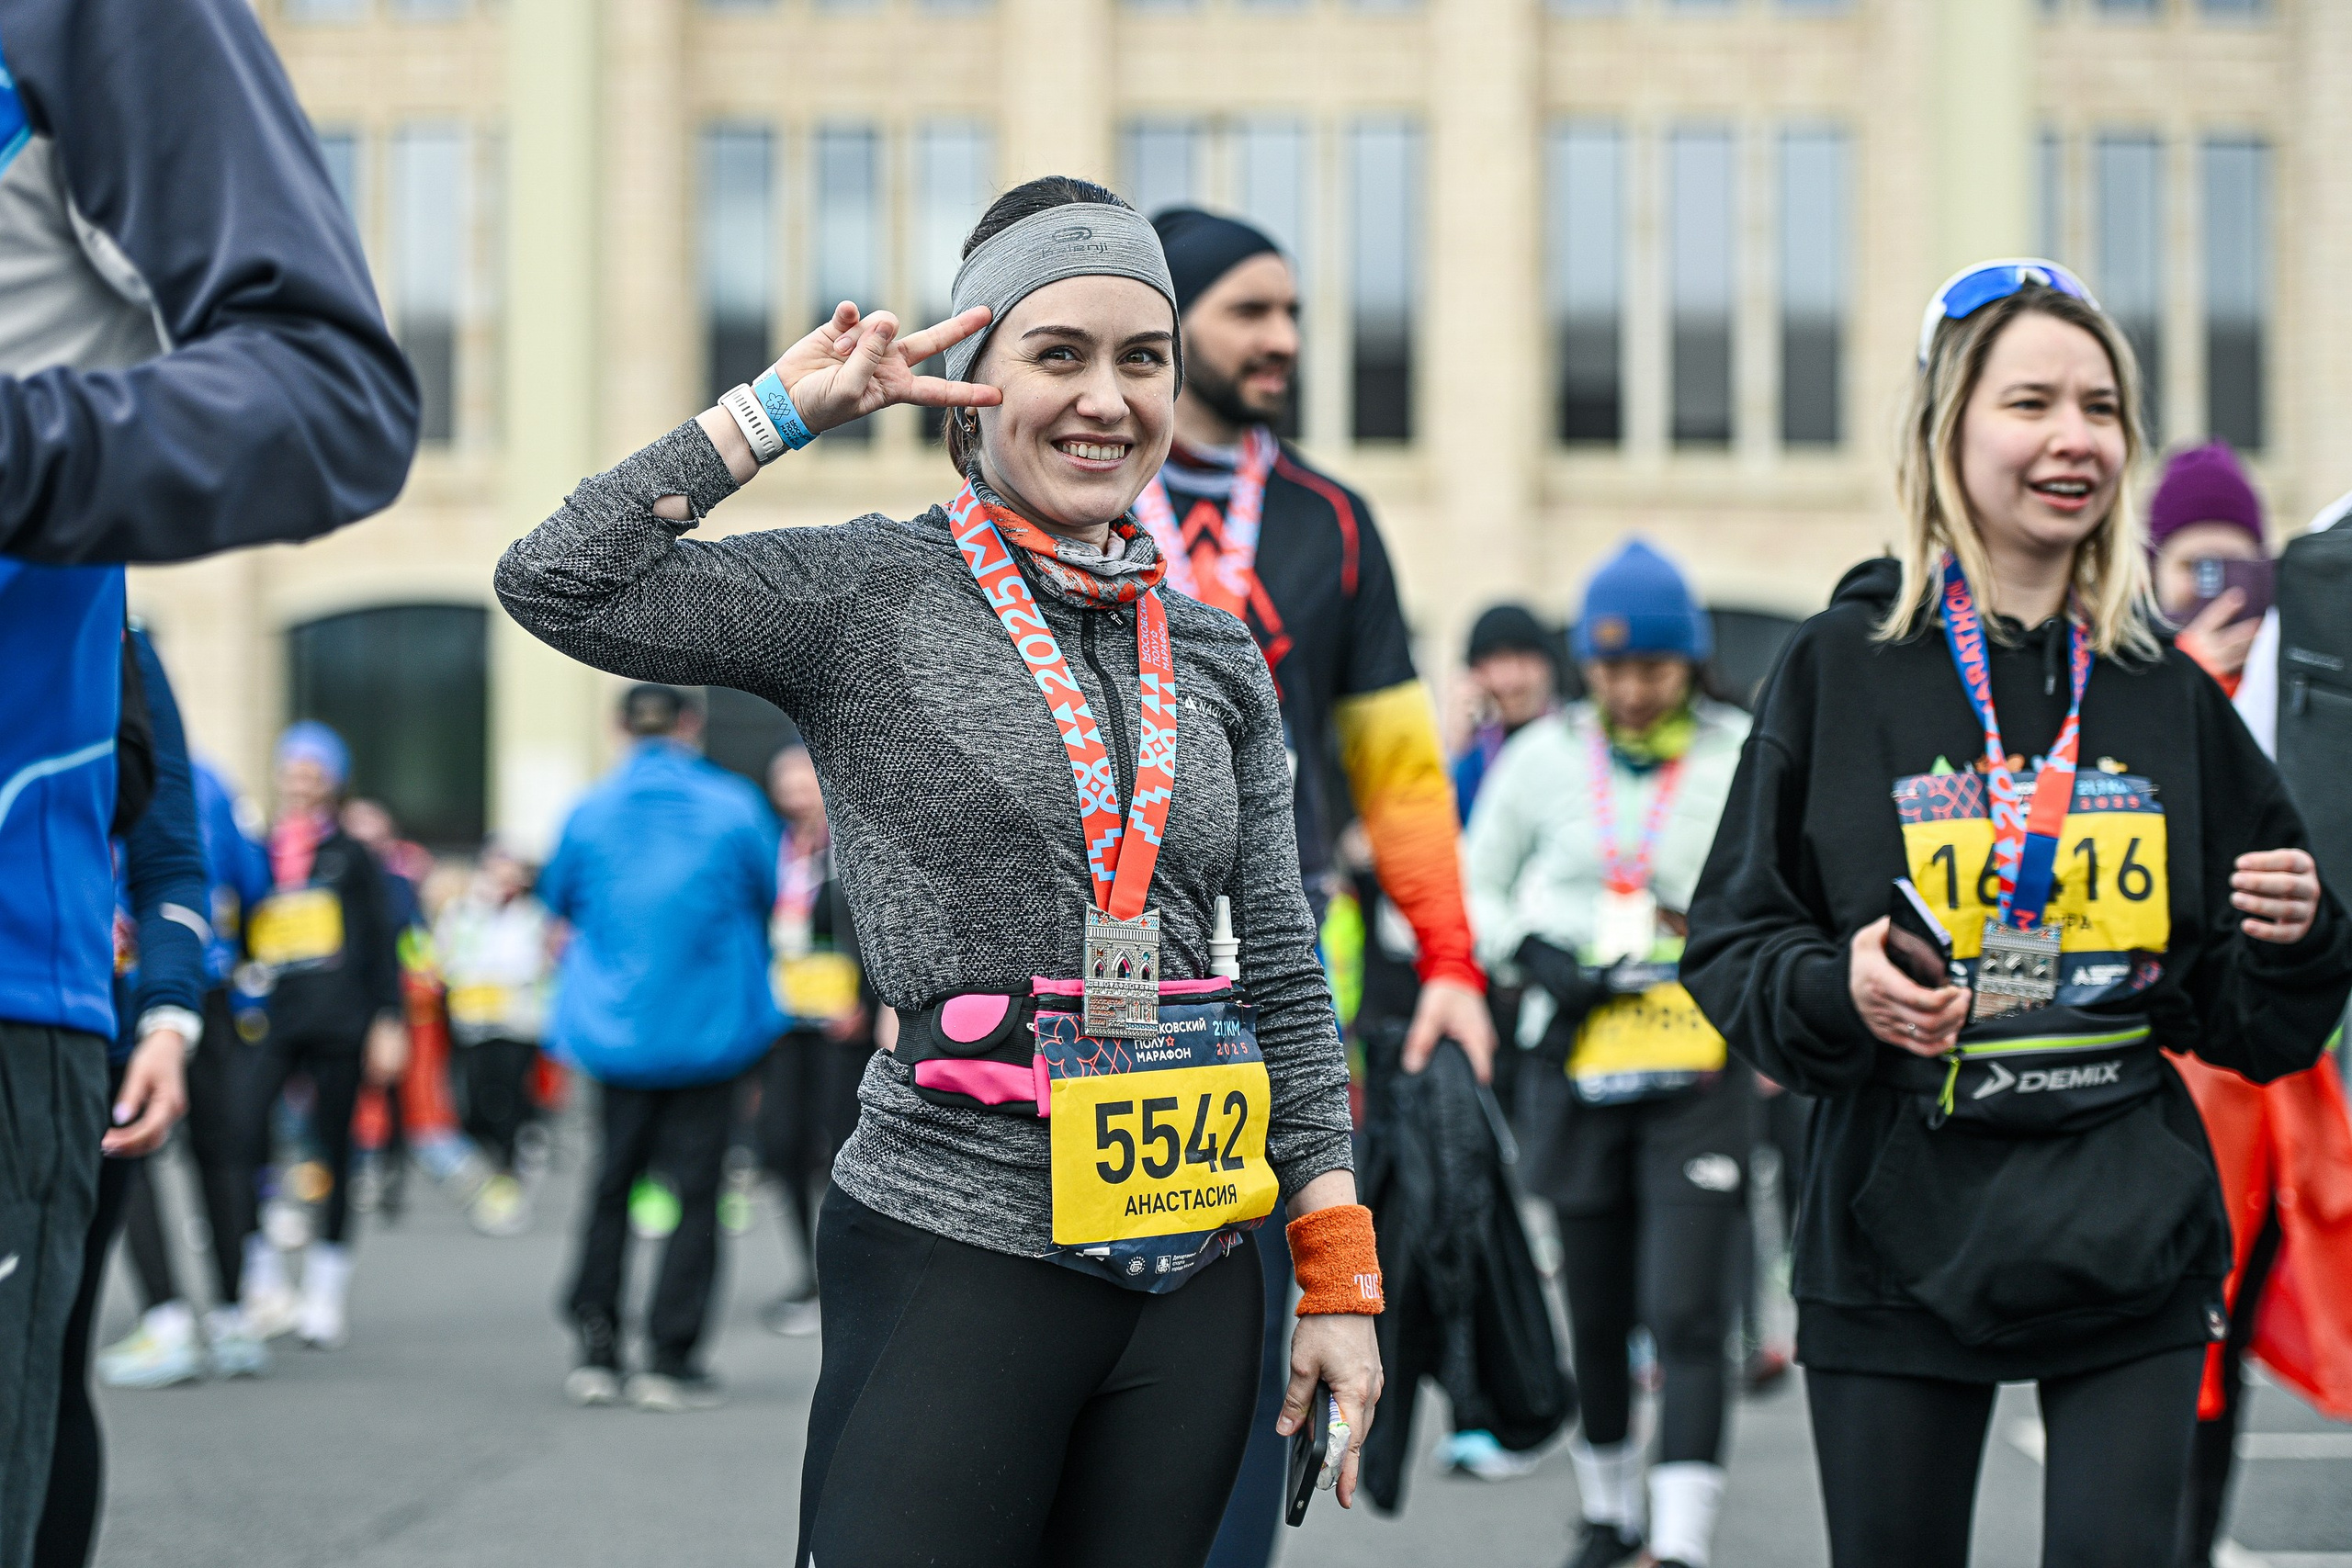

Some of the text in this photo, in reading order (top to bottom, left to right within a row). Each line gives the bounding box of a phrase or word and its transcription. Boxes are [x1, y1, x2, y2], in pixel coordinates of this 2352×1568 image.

[1151, 637, 1161, 667] ПОЛУ
[1158, 621, 1170, 671] МАРАФОН
[1932, 838, 2152, 908] 1616
[1158, 1017, 1206, 1034] КОВСКИЙ
[1134, 1036, 1165, 1050] ПОЛУ
[1136, 1047, 1192, 1063] МАРАФОН
[1216, 1042, 1249, 1056] 2025
[2015, 1060, 2123, 1093] DEMIX
[1094, 1090, 1248, 1185] 5542
[1124, 1183, 1238, 1217] АНАСТАСИЯ
